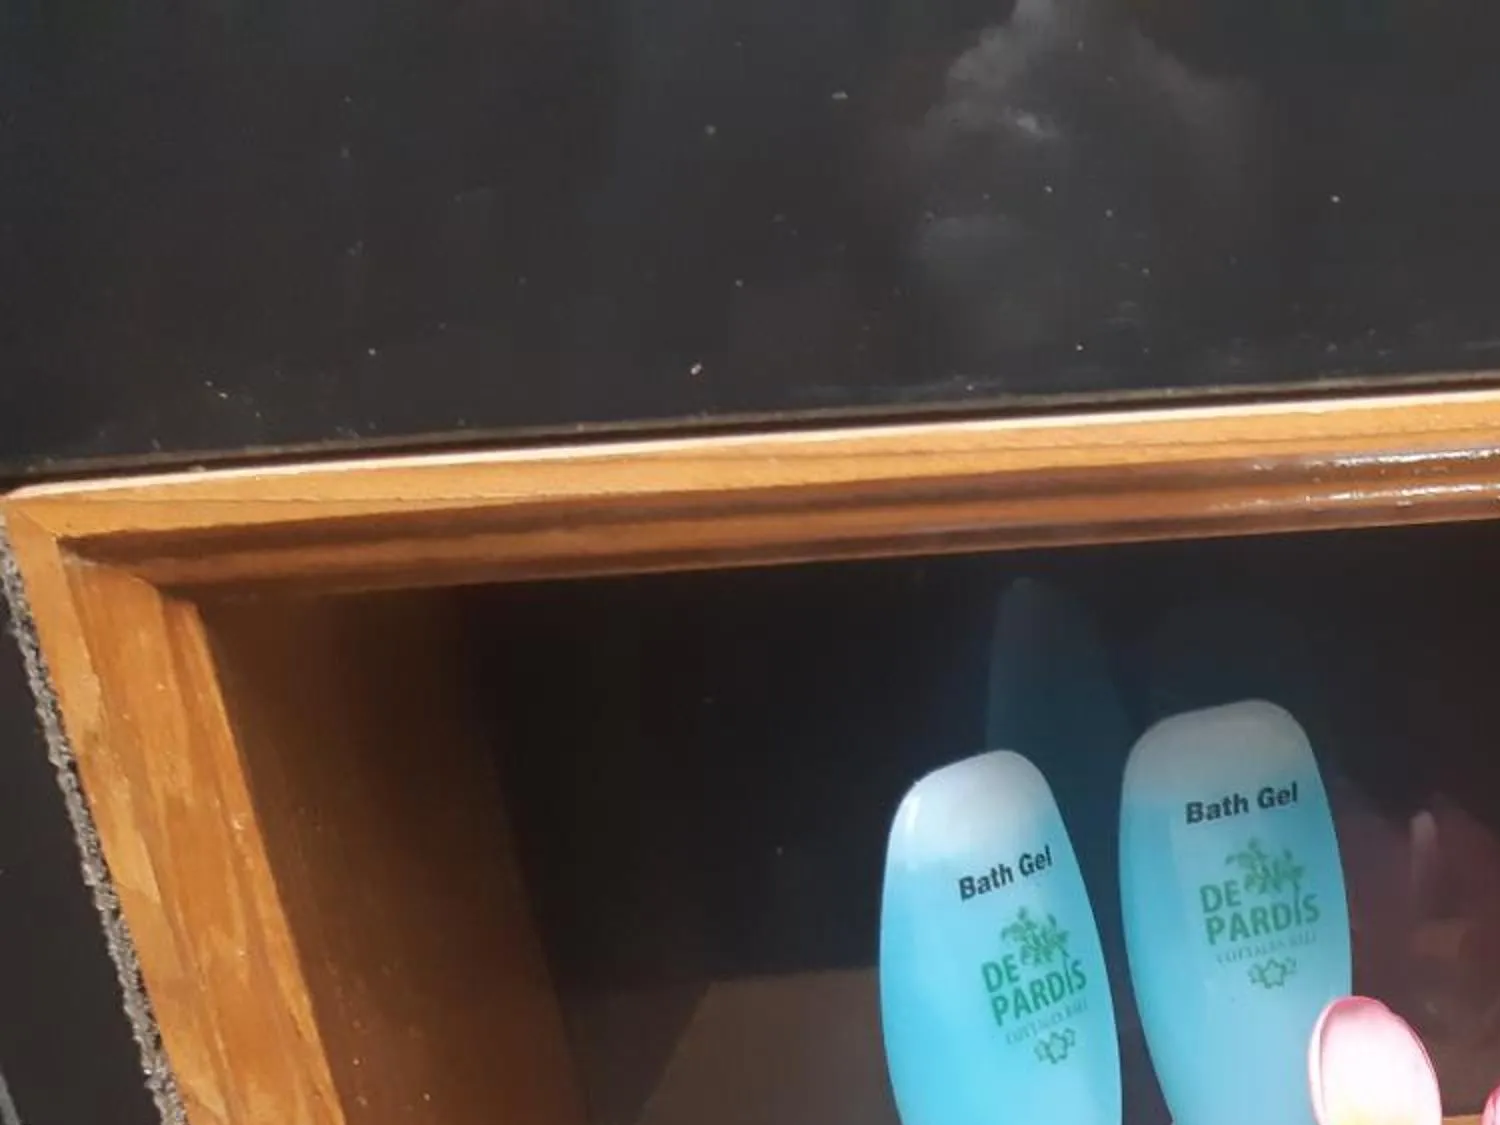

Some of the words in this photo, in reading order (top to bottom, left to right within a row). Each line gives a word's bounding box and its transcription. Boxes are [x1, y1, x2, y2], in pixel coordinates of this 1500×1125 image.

[1185, 793, 1249, 825] Bath
[1257, 781, 1298, 809] Gel
[958, 863, 1014, 901] Bath
[1018, 844, 1053, 877] Gel
[1200, 880, 1242, 914] DE
[1205, 893, 1320, 945] PARDIS
[982, 953, 1021, 994] DE
[991, 958, 1087, 1027] PARDIS
